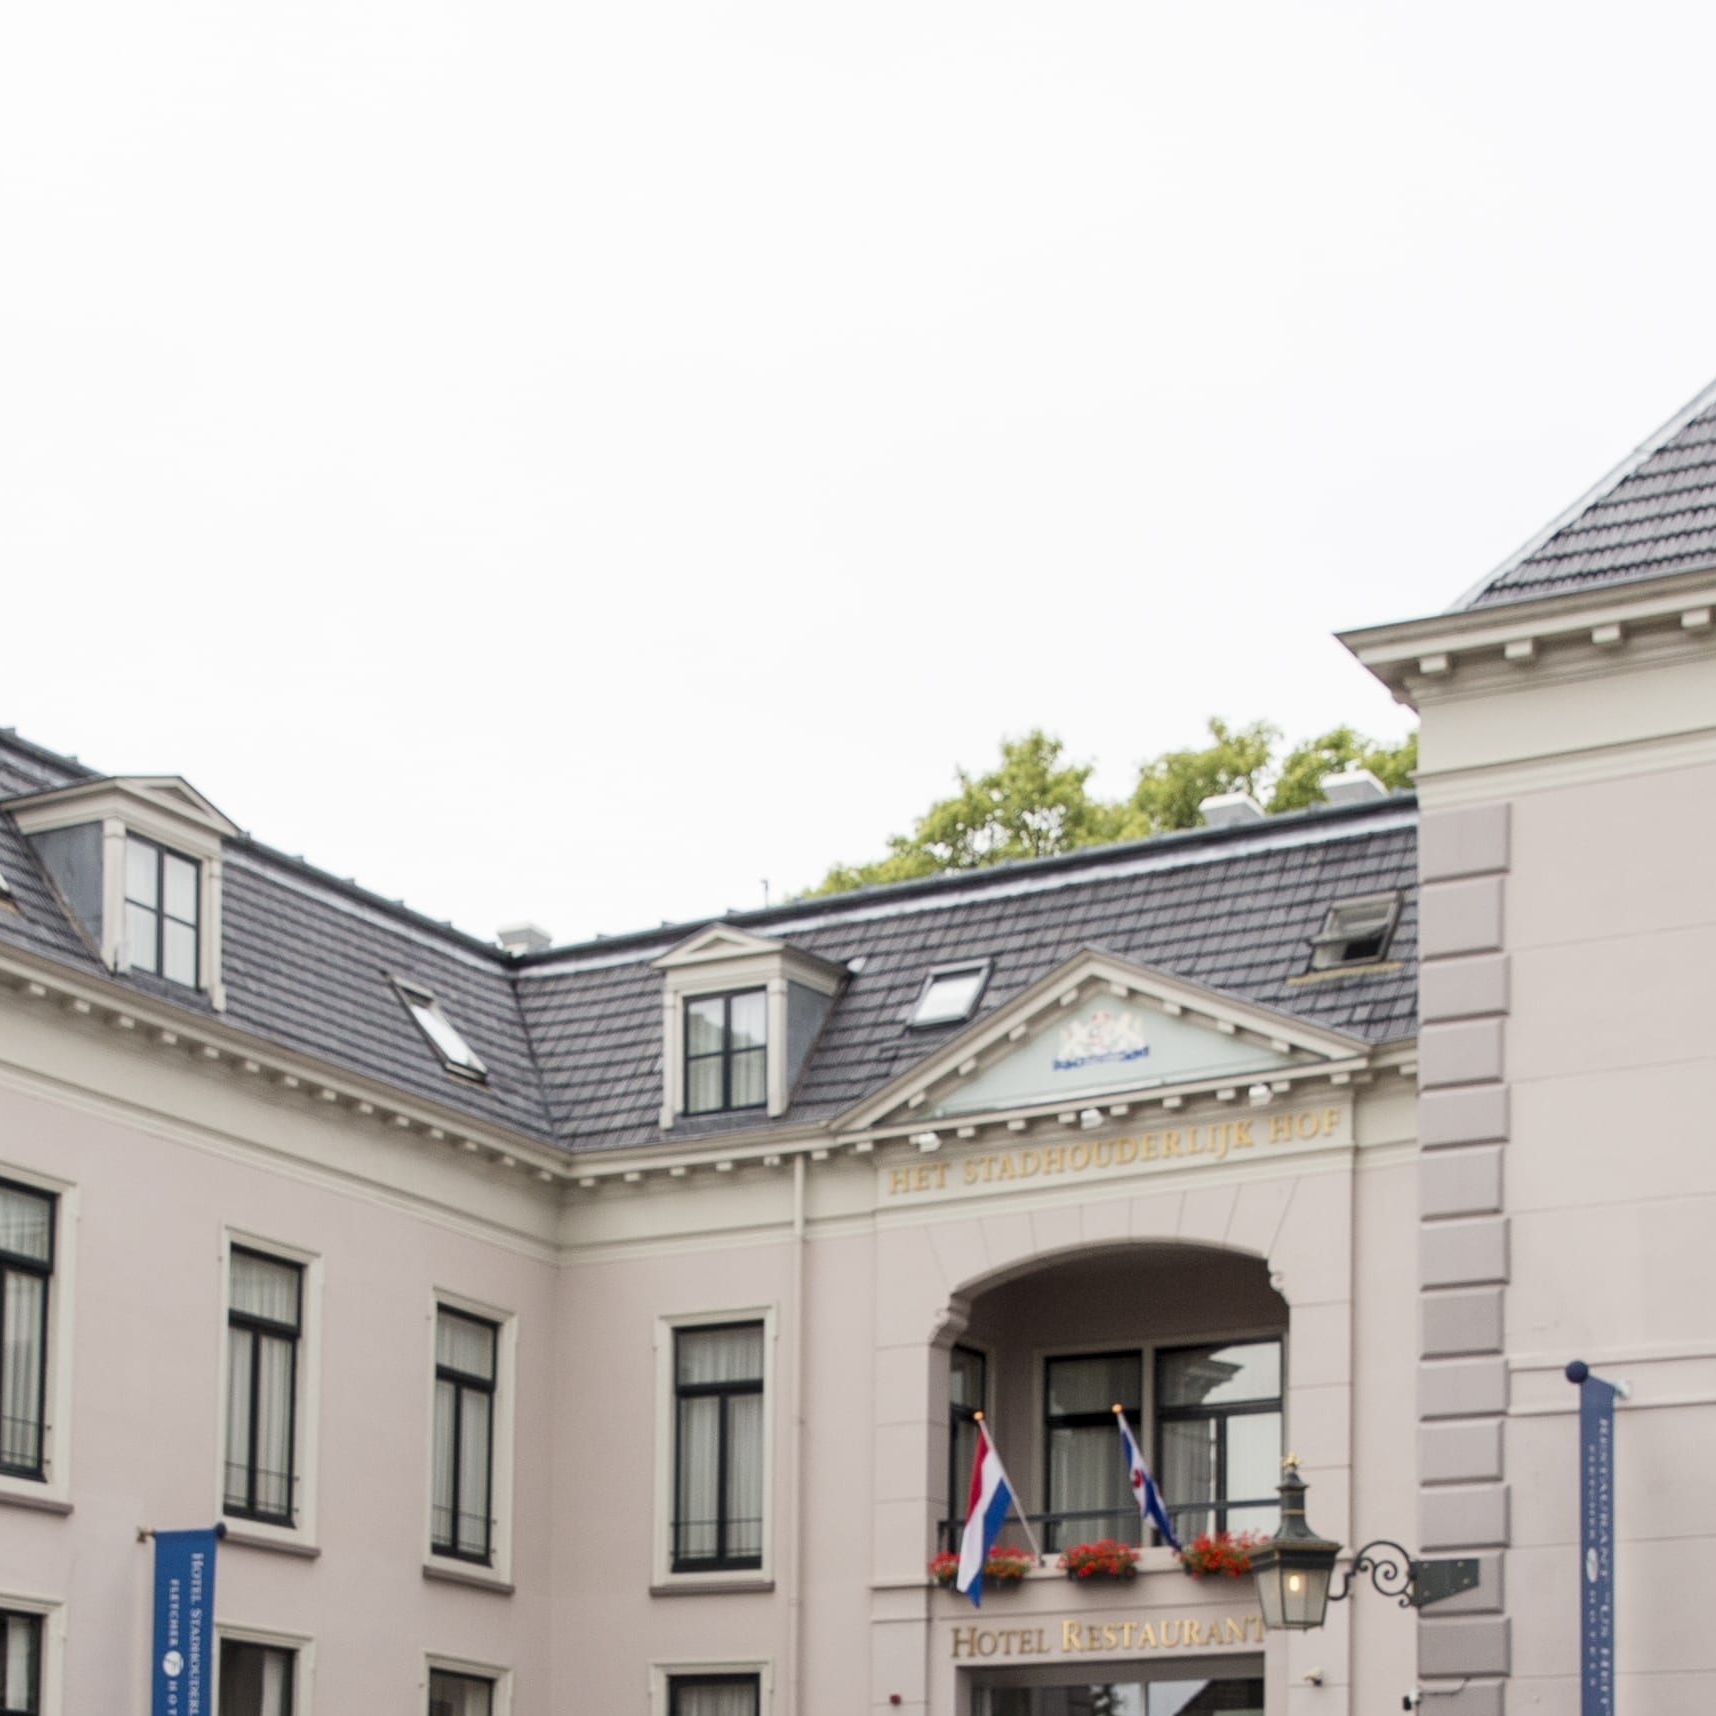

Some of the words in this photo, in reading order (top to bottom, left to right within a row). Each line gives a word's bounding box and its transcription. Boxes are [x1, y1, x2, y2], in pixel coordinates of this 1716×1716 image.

[889, 1161, 951, 1195] HET
[963, 1119, 1254, 1185] STADHOUDERLIJK
[1268, 1106, 1341, 1144] HOF
[951, 1626, 1051, 1658] HOTEL
[1061, 1615, 1265, 1653] RESTAURANT
